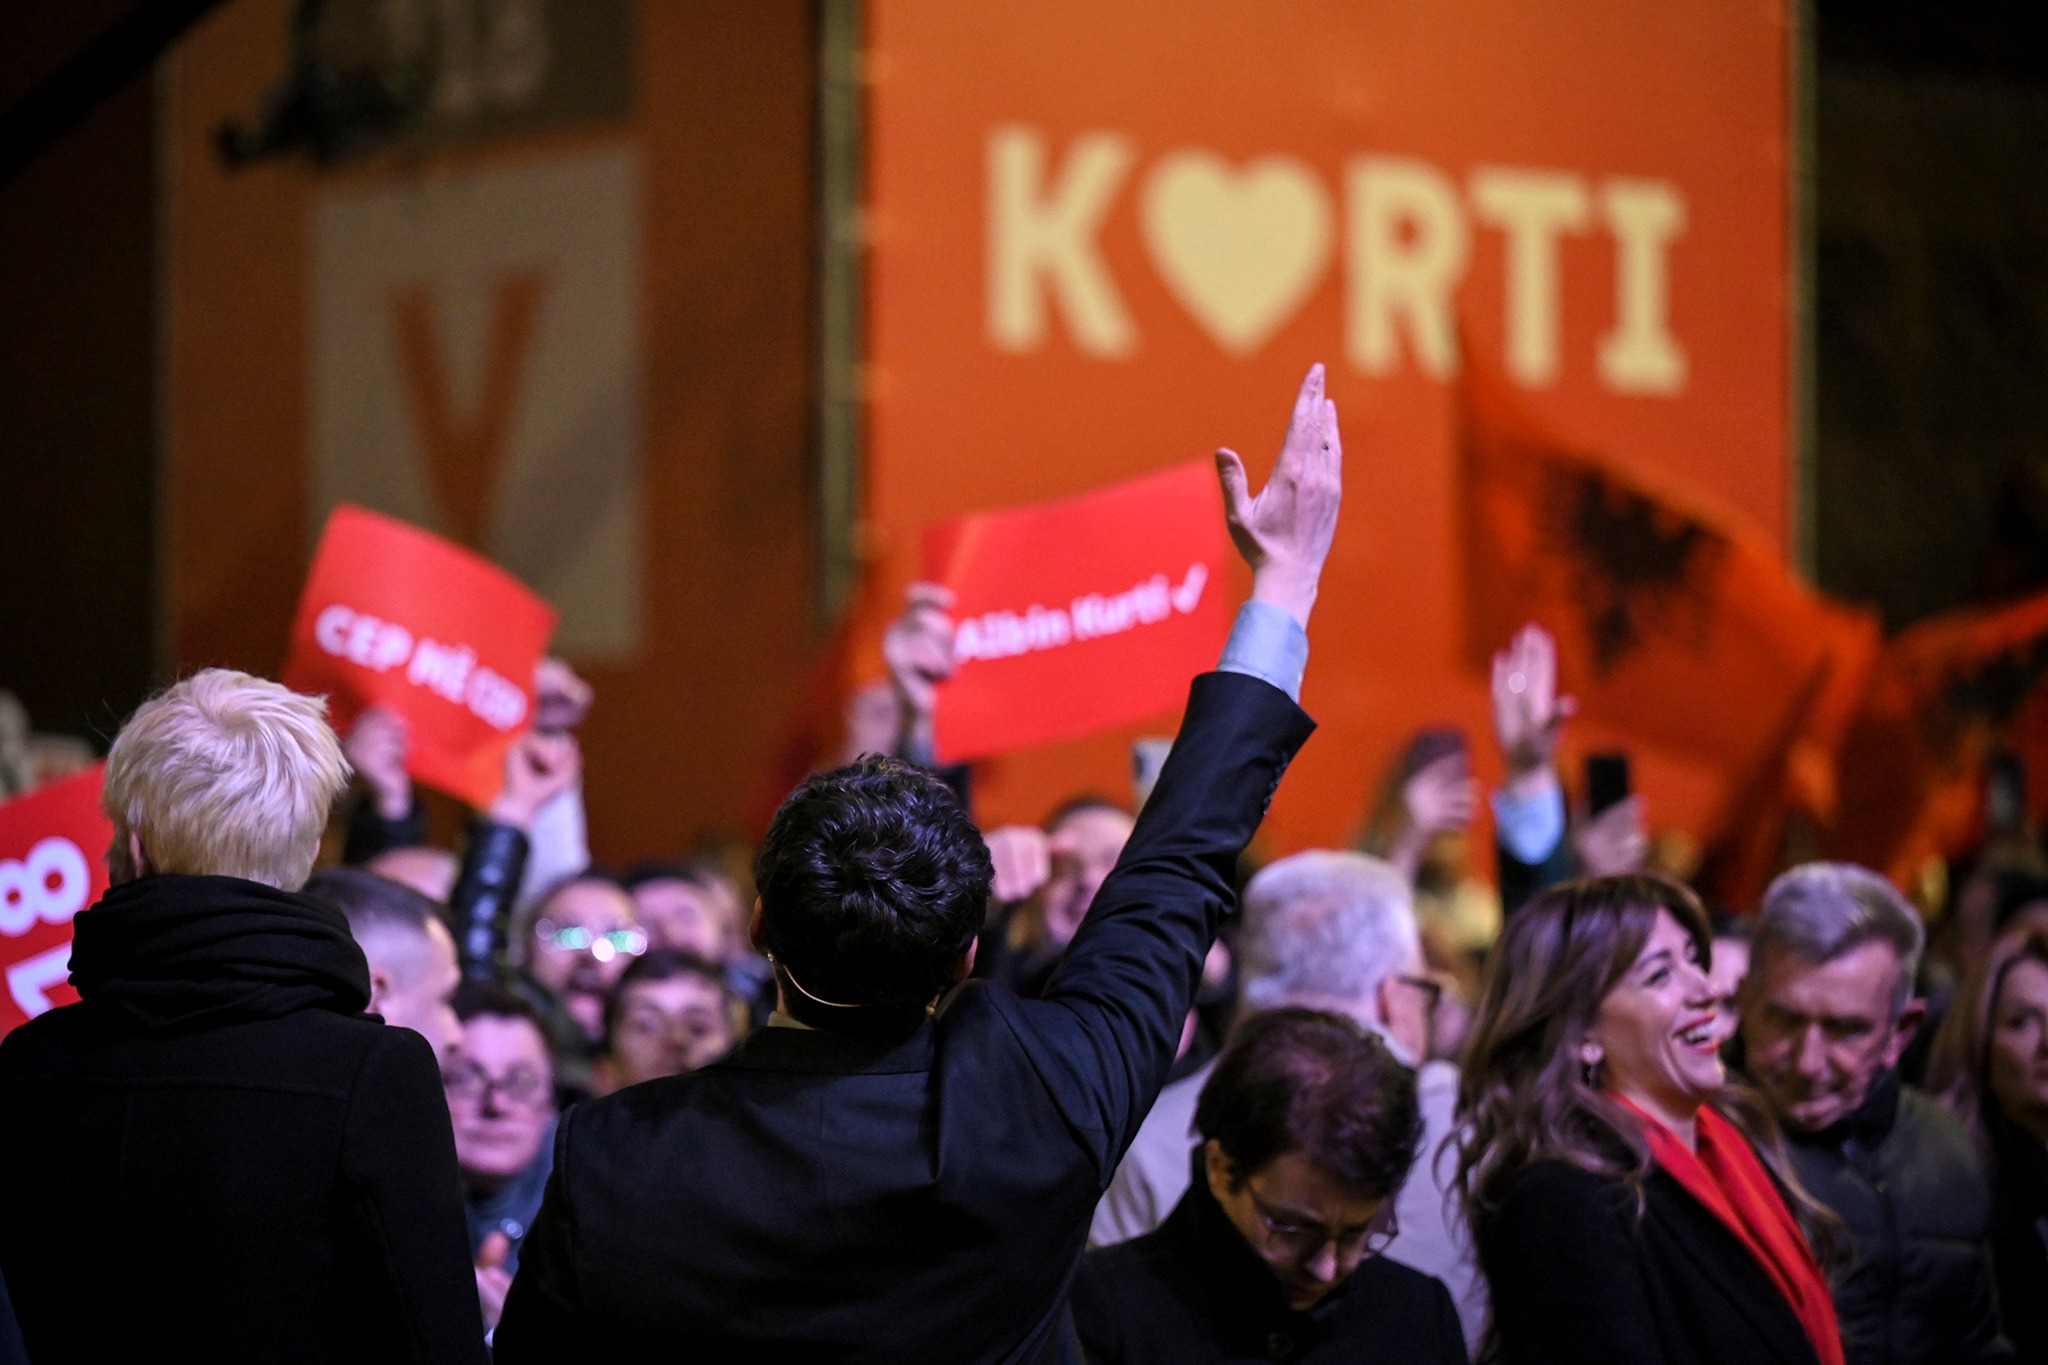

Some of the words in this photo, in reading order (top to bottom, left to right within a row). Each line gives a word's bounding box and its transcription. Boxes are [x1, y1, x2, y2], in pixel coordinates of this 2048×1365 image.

[390, 268, 552, 550] V
[953, 602, 1071, 664] Albin
[1070, 572, 1173, 641] Kurti
